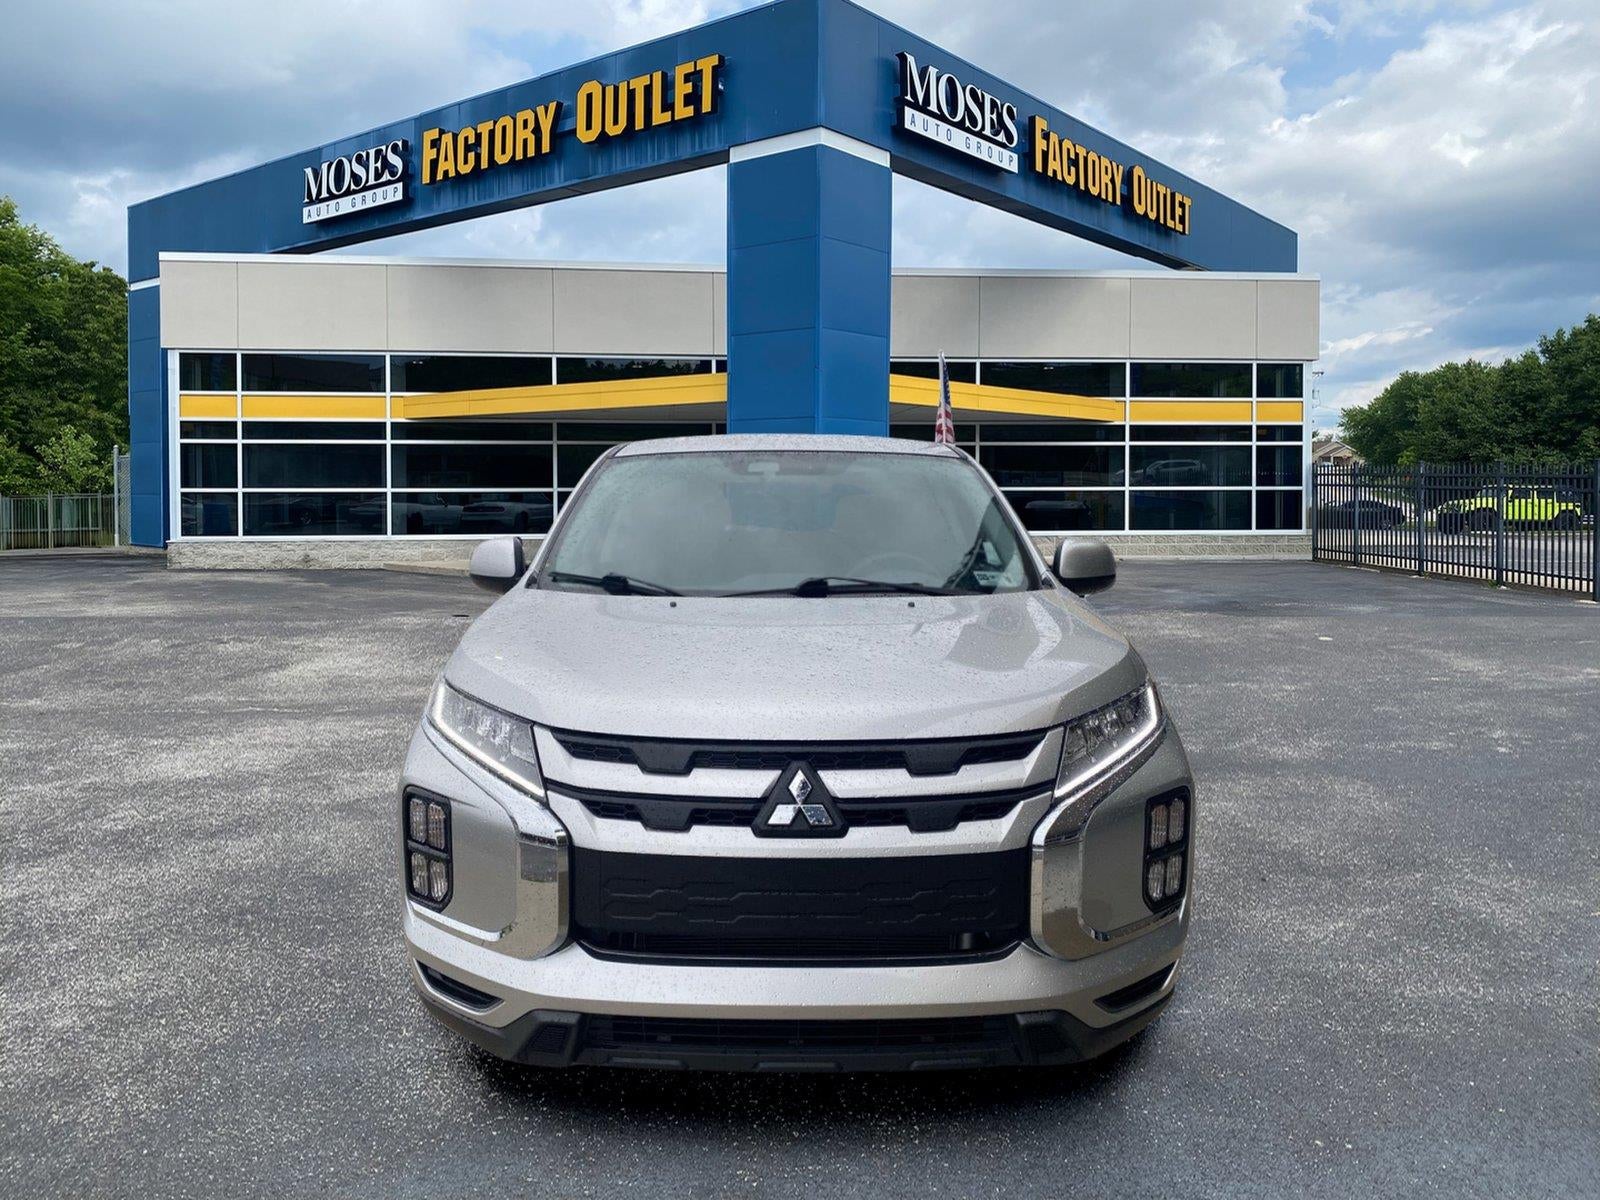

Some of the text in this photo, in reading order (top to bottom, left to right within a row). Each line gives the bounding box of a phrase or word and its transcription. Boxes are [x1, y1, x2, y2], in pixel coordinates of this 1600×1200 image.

[903, 52, 1018, 148] MOSES
[910, 113, 1015, 168] AUTO GROUP
[303, 139, 404, 203] MOSES
[307, 186, 399, 219] AUTO GROUP
